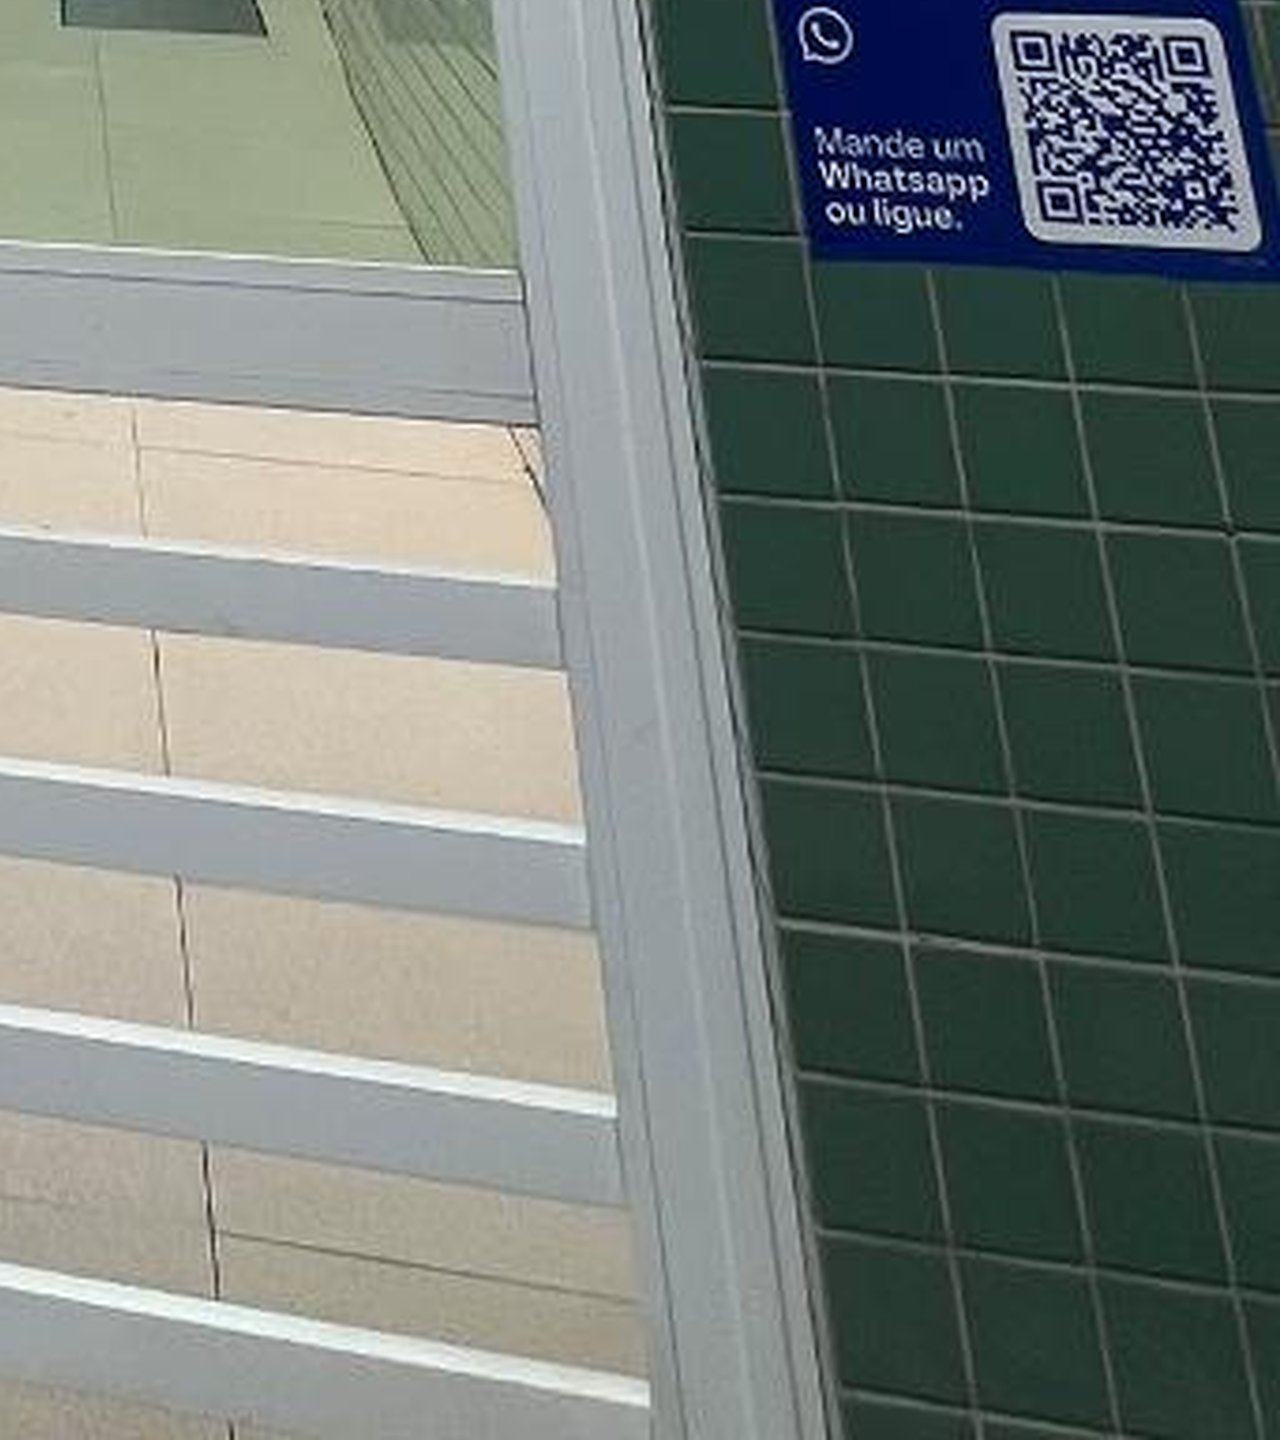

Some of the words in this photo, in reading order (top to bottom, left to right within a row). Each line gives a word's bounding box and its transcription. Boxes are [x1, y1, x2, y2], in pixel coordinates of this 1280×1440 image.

[814, 126, 925, 159] Mande
[933, 137, 986, 162] um
[818, 160, 990, 202] Whatsapp
[825, 202, 865, 225] ou
[873, 198, 963, 235] ligue.
